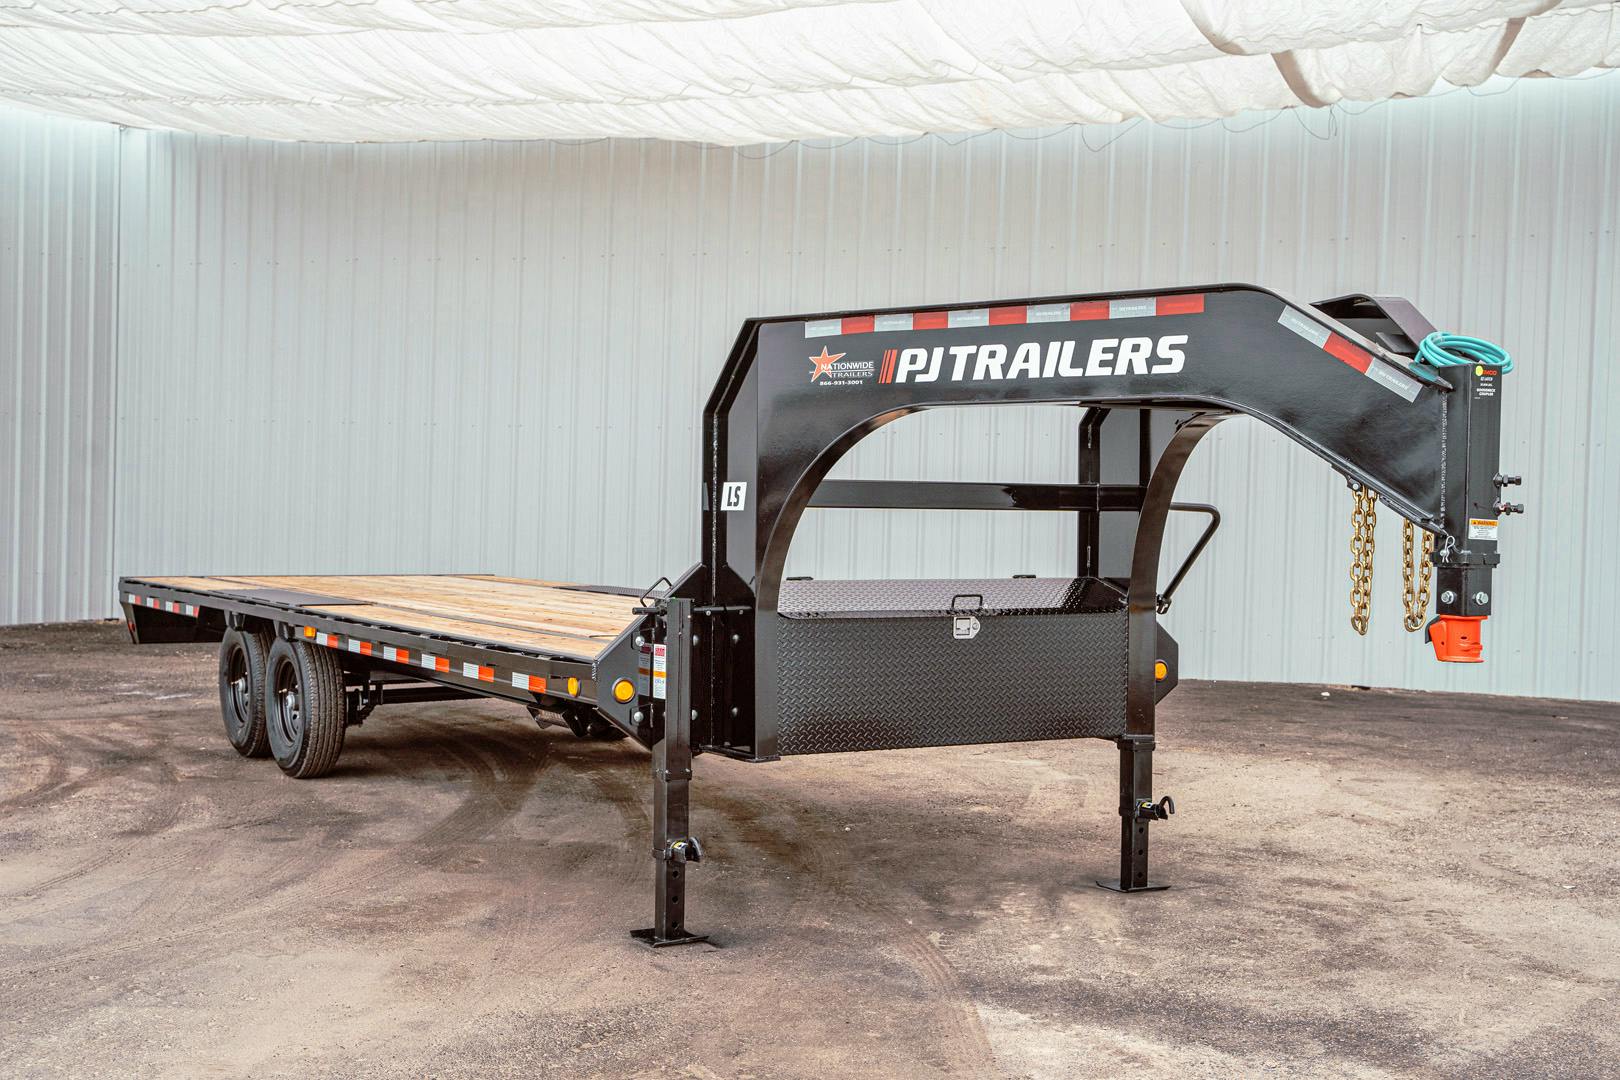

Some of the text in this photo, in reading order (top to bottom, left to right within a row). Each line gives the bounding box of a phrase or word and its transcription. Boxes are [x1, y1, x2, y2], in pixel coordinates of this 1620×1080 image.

[821, 361, 874, 370] NATIONWIDE
[895, 334, 1189, 383] PJ TRAILERS
[727, 485, 742, 507] LS
